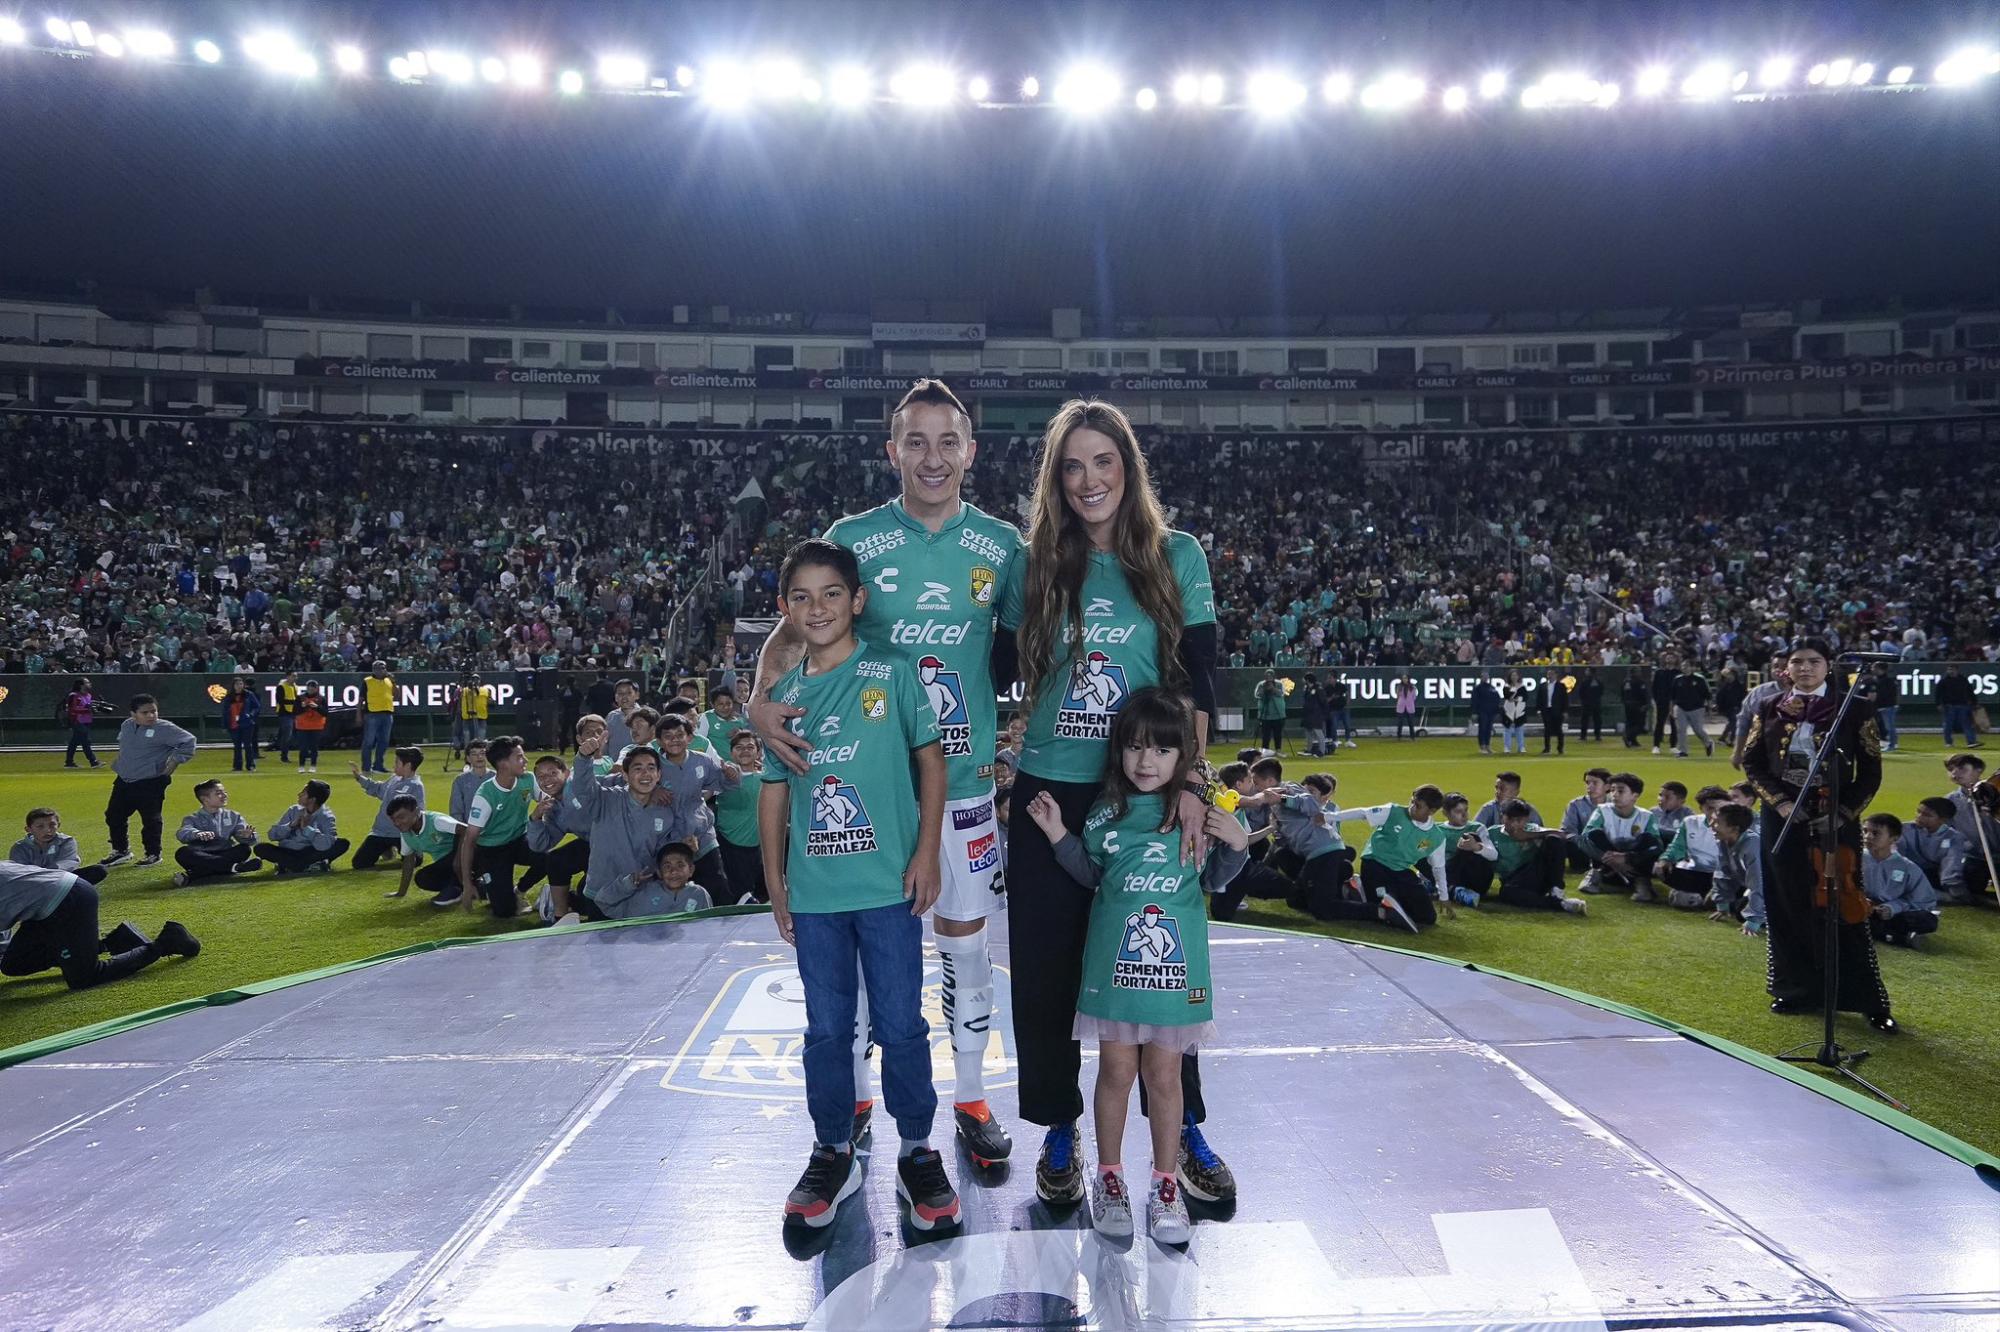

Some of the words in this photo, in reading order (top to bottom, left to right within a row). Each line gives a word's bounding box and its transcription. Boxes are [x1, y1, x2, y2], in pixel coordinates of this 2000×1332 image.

[343, 364, 437, 379] caliente.mx
[1713, 366, 1794, 384] Primera
[1801, 364, 1847, 380] Plus
[1870, 360, 1957, 377] Primera
[511, 369, 601, 385] caliente.mx
[671, 373, 757, 388] caliente.mx
[824, 376, 909, 390] caliente.mx
[970, 378, 1008, 389] CHARLY
[1028, 379, 1067, 389] CHARLY
[1125, 377, 1208, 390] caliente.mx
[1274, 377, 1358, 390] caliente.mx
[1417, 377, 1457, 388] CHARLY
[1476, 376, 1516, 387] CHARLY
[1569, 374, 1610, 385] CHARLY
[1631, 372, 1672, 383] CHARLY
[1740, 431, 1780, 446] HACE
[853, 528, 904, 555] Office
[962, 528, 1007, 559] Office
[858, 536, 906, 564] DEPOT
[958, 536, 1004, 566] DEPOT
[890, 618, 972, 645] telcel
[857, 661, 893, 673] Office
[856, 669, 891, 681] DEPOT
[1424, 678, 1455, 699] EN
[1059, 711, 1117, 726] CEMENT
[1055, 724, 1113, 738] FORTAL
[808, 827, 874, 844] CEMENTOS
[807, 840, 877, 856] FORTALEZA
[1123, 872, 1183, 893] telcel
[1115, 962, 1187, 977] CEMENTOS
[1114, 975, 1188, 989] FORTALEZA
